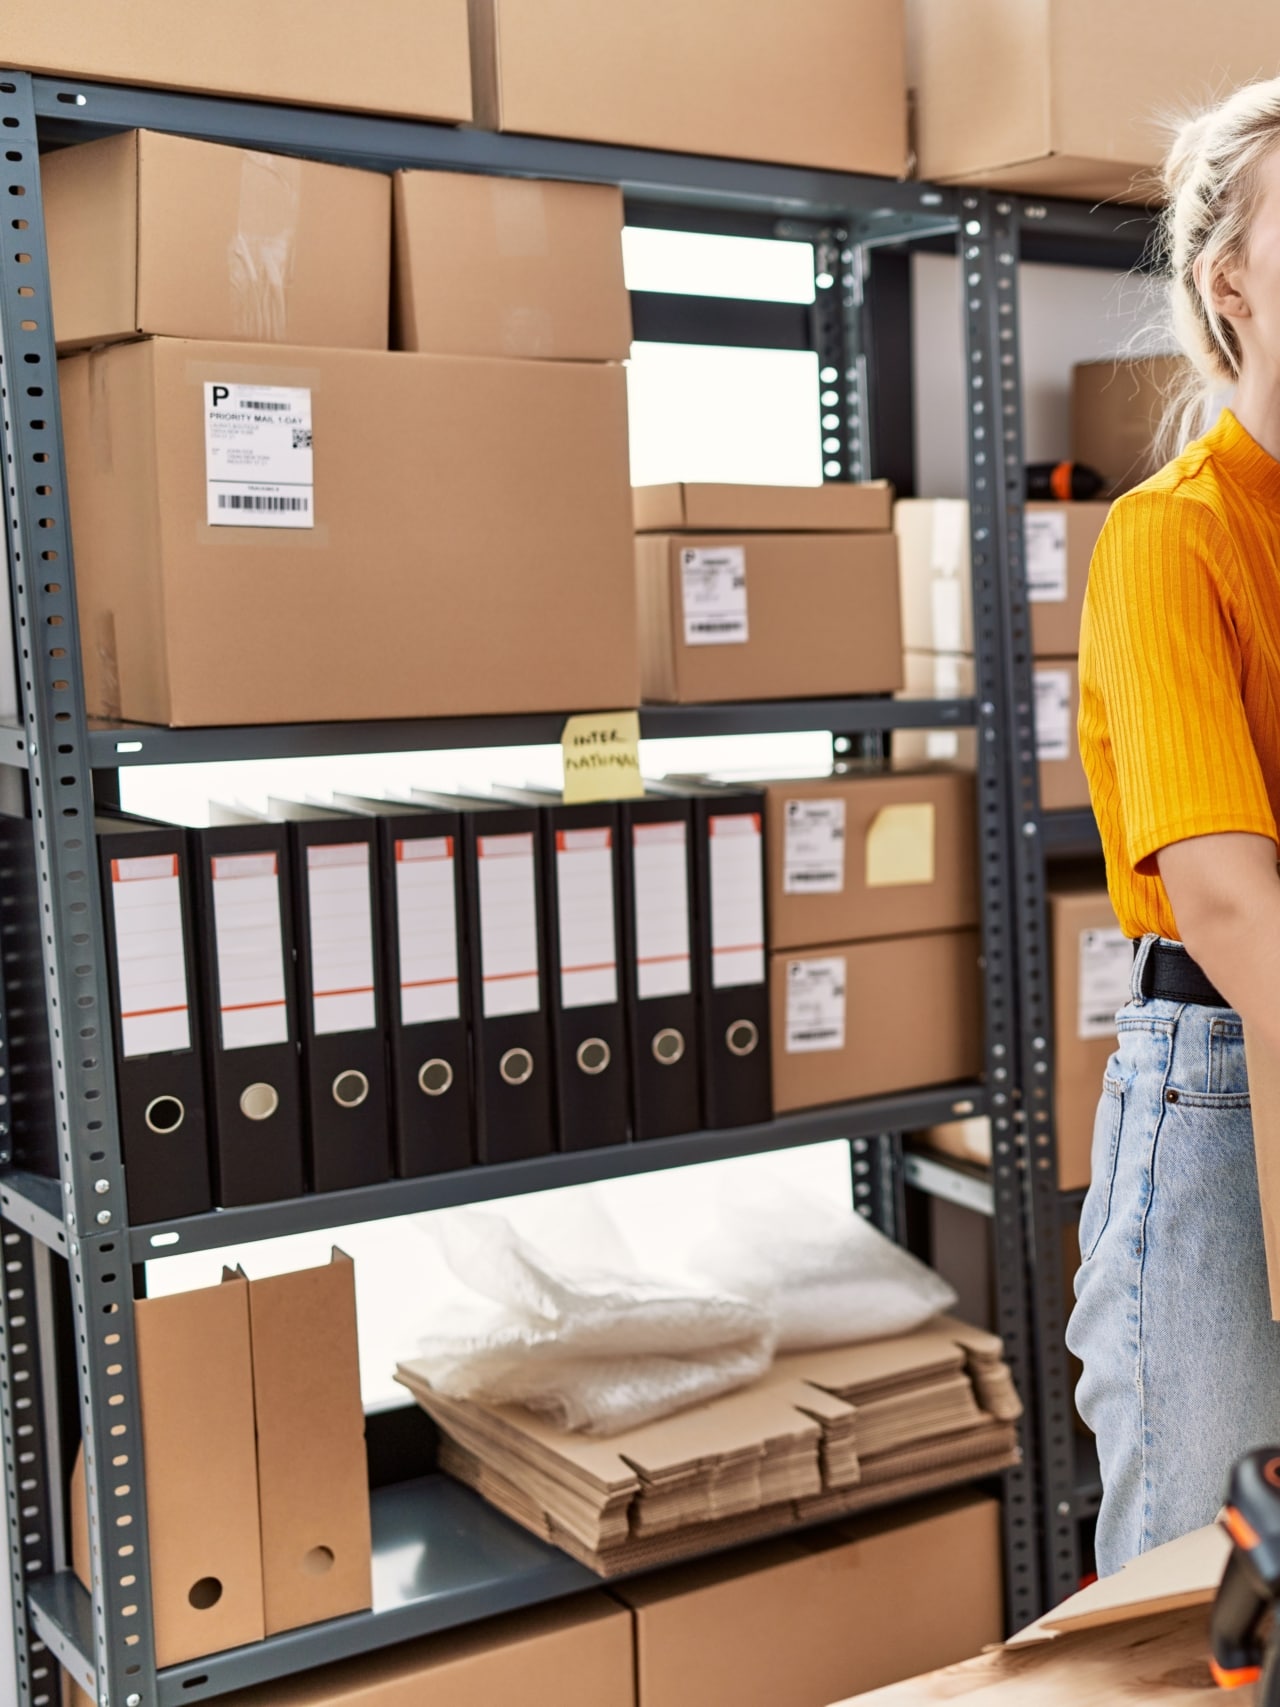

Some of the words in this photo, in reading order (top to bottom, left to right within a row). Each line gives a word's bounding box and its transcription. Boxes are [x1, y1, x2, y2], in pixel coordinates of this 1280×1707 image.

[212, 385, 229, 407] P
[209, 412, 251, 422] PRIORITY
[254, 415, 273, 423] MAIL
